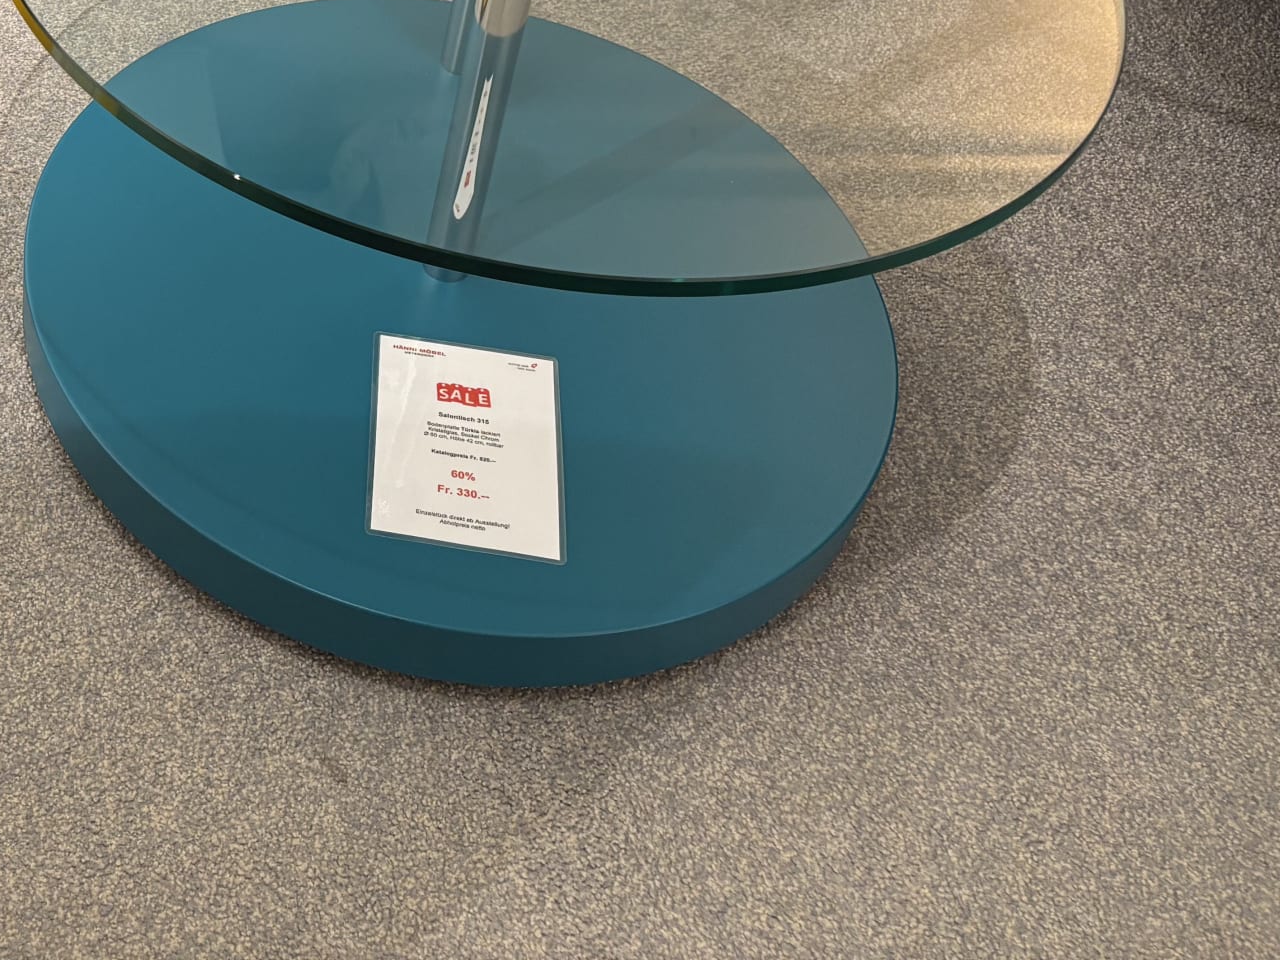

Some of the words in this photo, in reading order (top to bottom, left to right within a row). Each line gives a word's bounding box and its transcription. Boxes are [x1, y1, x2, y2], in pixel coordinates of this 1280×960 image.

[439, 389, 489, 405] SALE
[438, 411, 476, 422] Salontisch
[431, 449, 469, 459] Katalogpreis
[451, 470, 476, 482] 60%
[437, 484, 453, 495] Fr.
